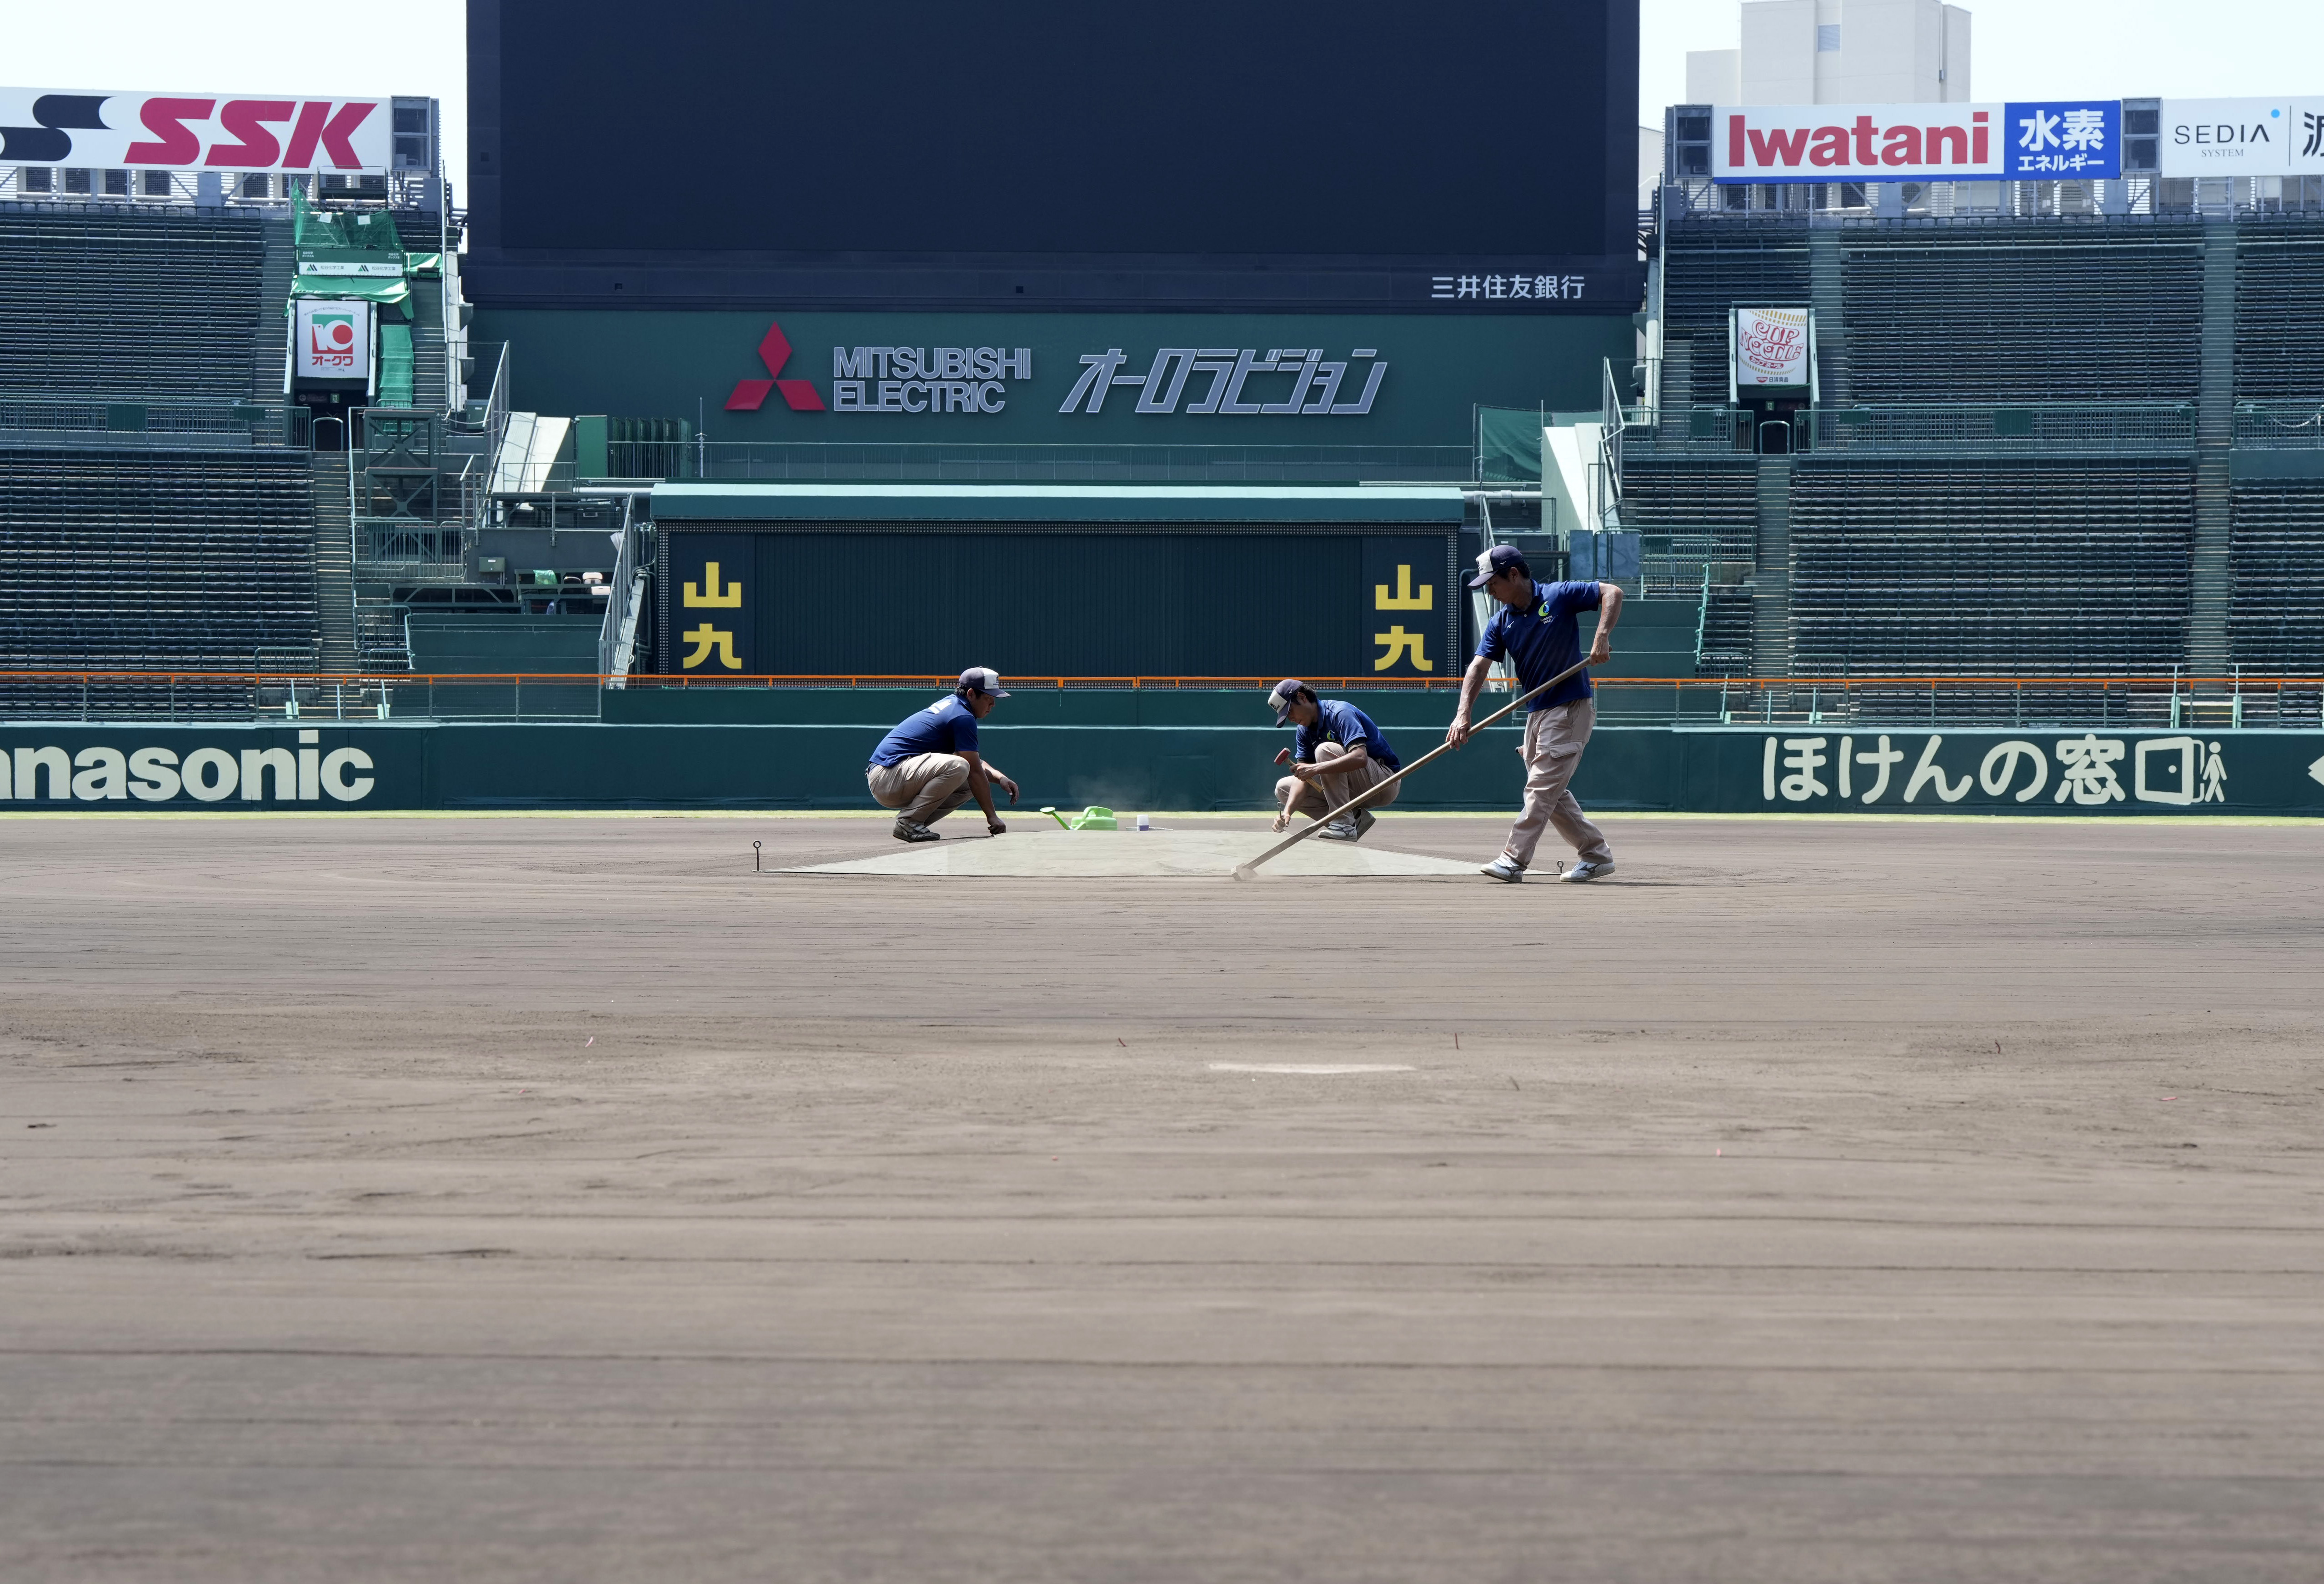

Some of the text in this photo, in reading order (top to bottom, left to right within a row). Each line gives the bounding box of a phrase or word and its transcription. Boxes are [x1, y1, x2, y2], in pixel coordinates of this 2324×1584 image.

[123, 97, 378, 170] SSK
[1729, 112, 1988, 167] Iwatani
[2018, 109, 2105, 151] 水素
[2018, 154, 2104, 171] エネルギー
[2201, 149, 2244, 157] SYSTEM
[1431, 274, 1585, 300] 三井住友銀行
[1739, 327, 1804, 362] NOODLE
[1752, 319, 1800, 345] CUP
[312, 355, 353, 366] オークワ
[834, 347, 1031, 380] MITSUBISHI
[834, 380, 1005, 413] ELECTRIC
[1059, 348, 1388, 414] オーロラビジョン
[683, 562, 742, 670] 山九
[1375, 565, 1433, 671] 山九
[0, 730, 374, 802] nasonic
